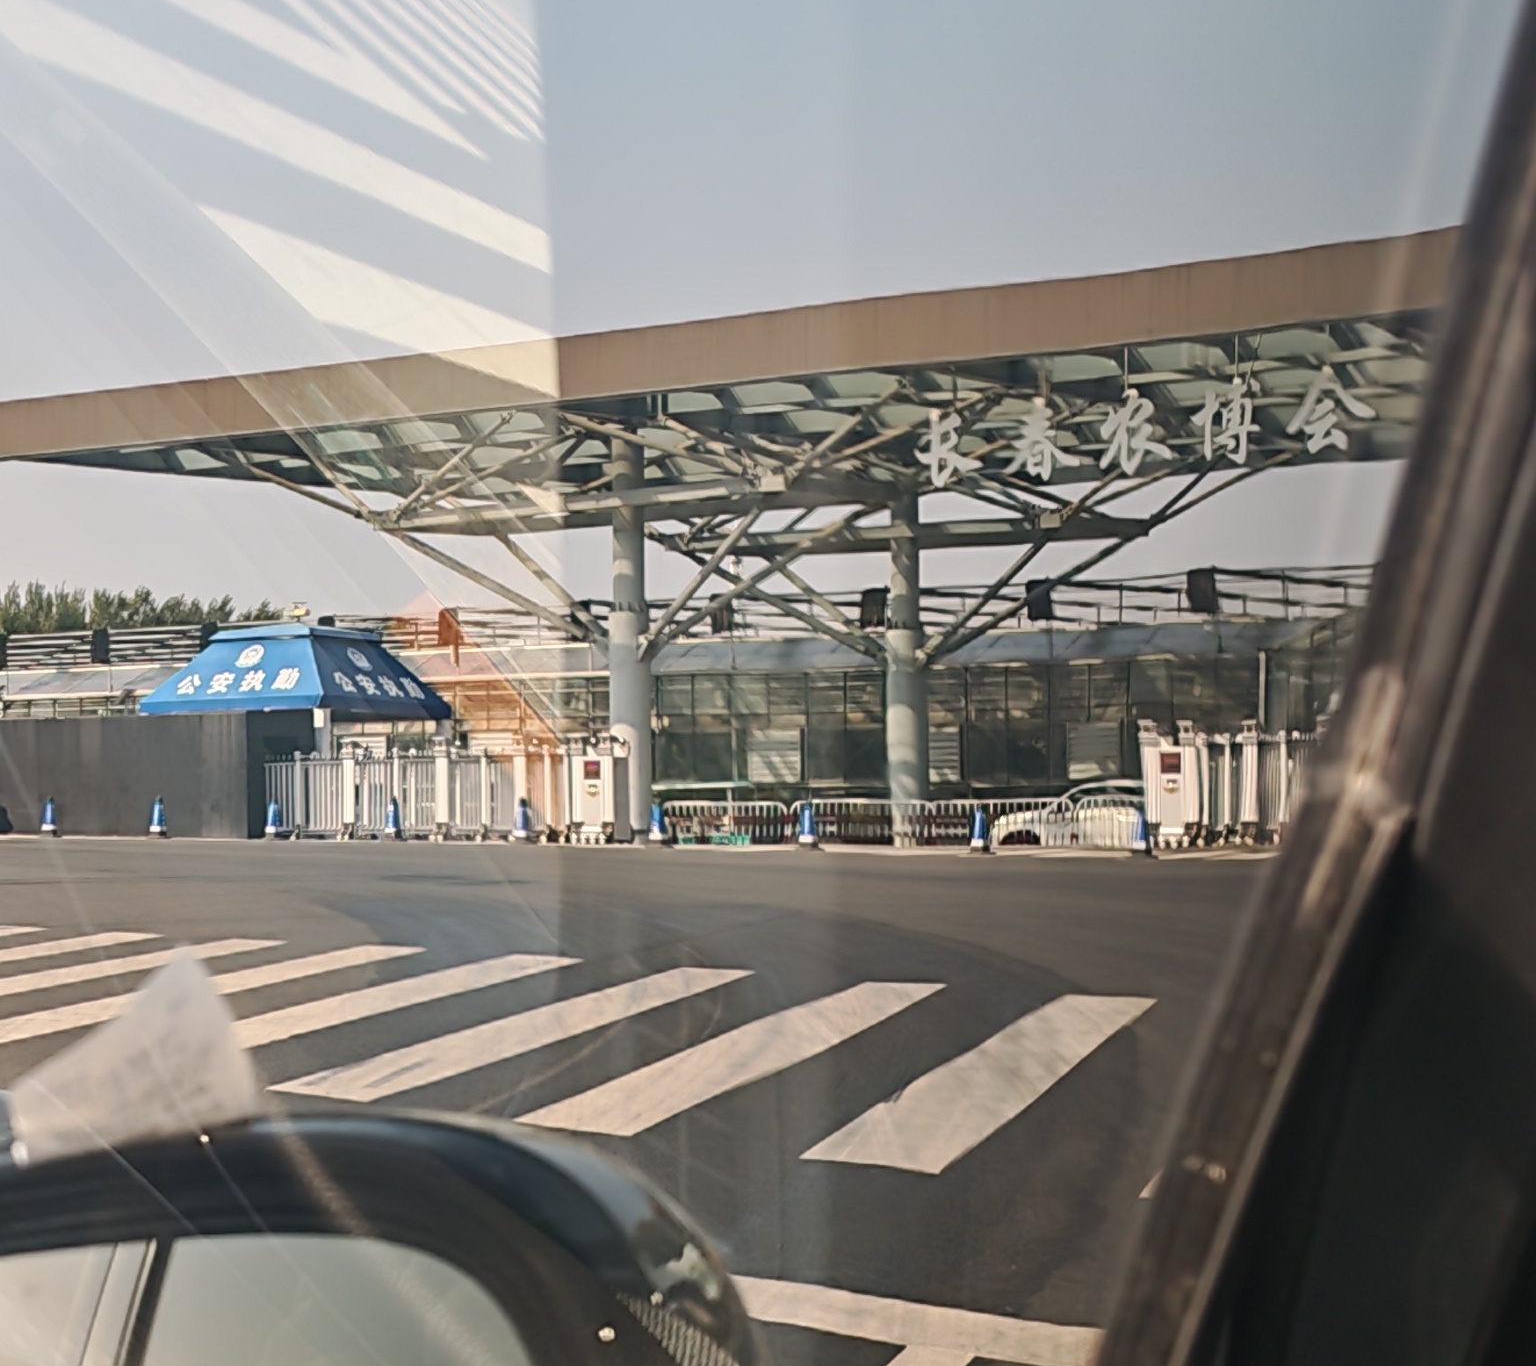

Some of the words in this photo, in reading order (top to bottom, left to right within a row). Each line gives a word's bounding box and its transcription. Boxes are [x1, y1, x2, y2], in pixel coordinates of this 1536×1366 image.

[176, 667, 302, 696] 公安执勤
[333, 670, 426, 700] 公安执勤
